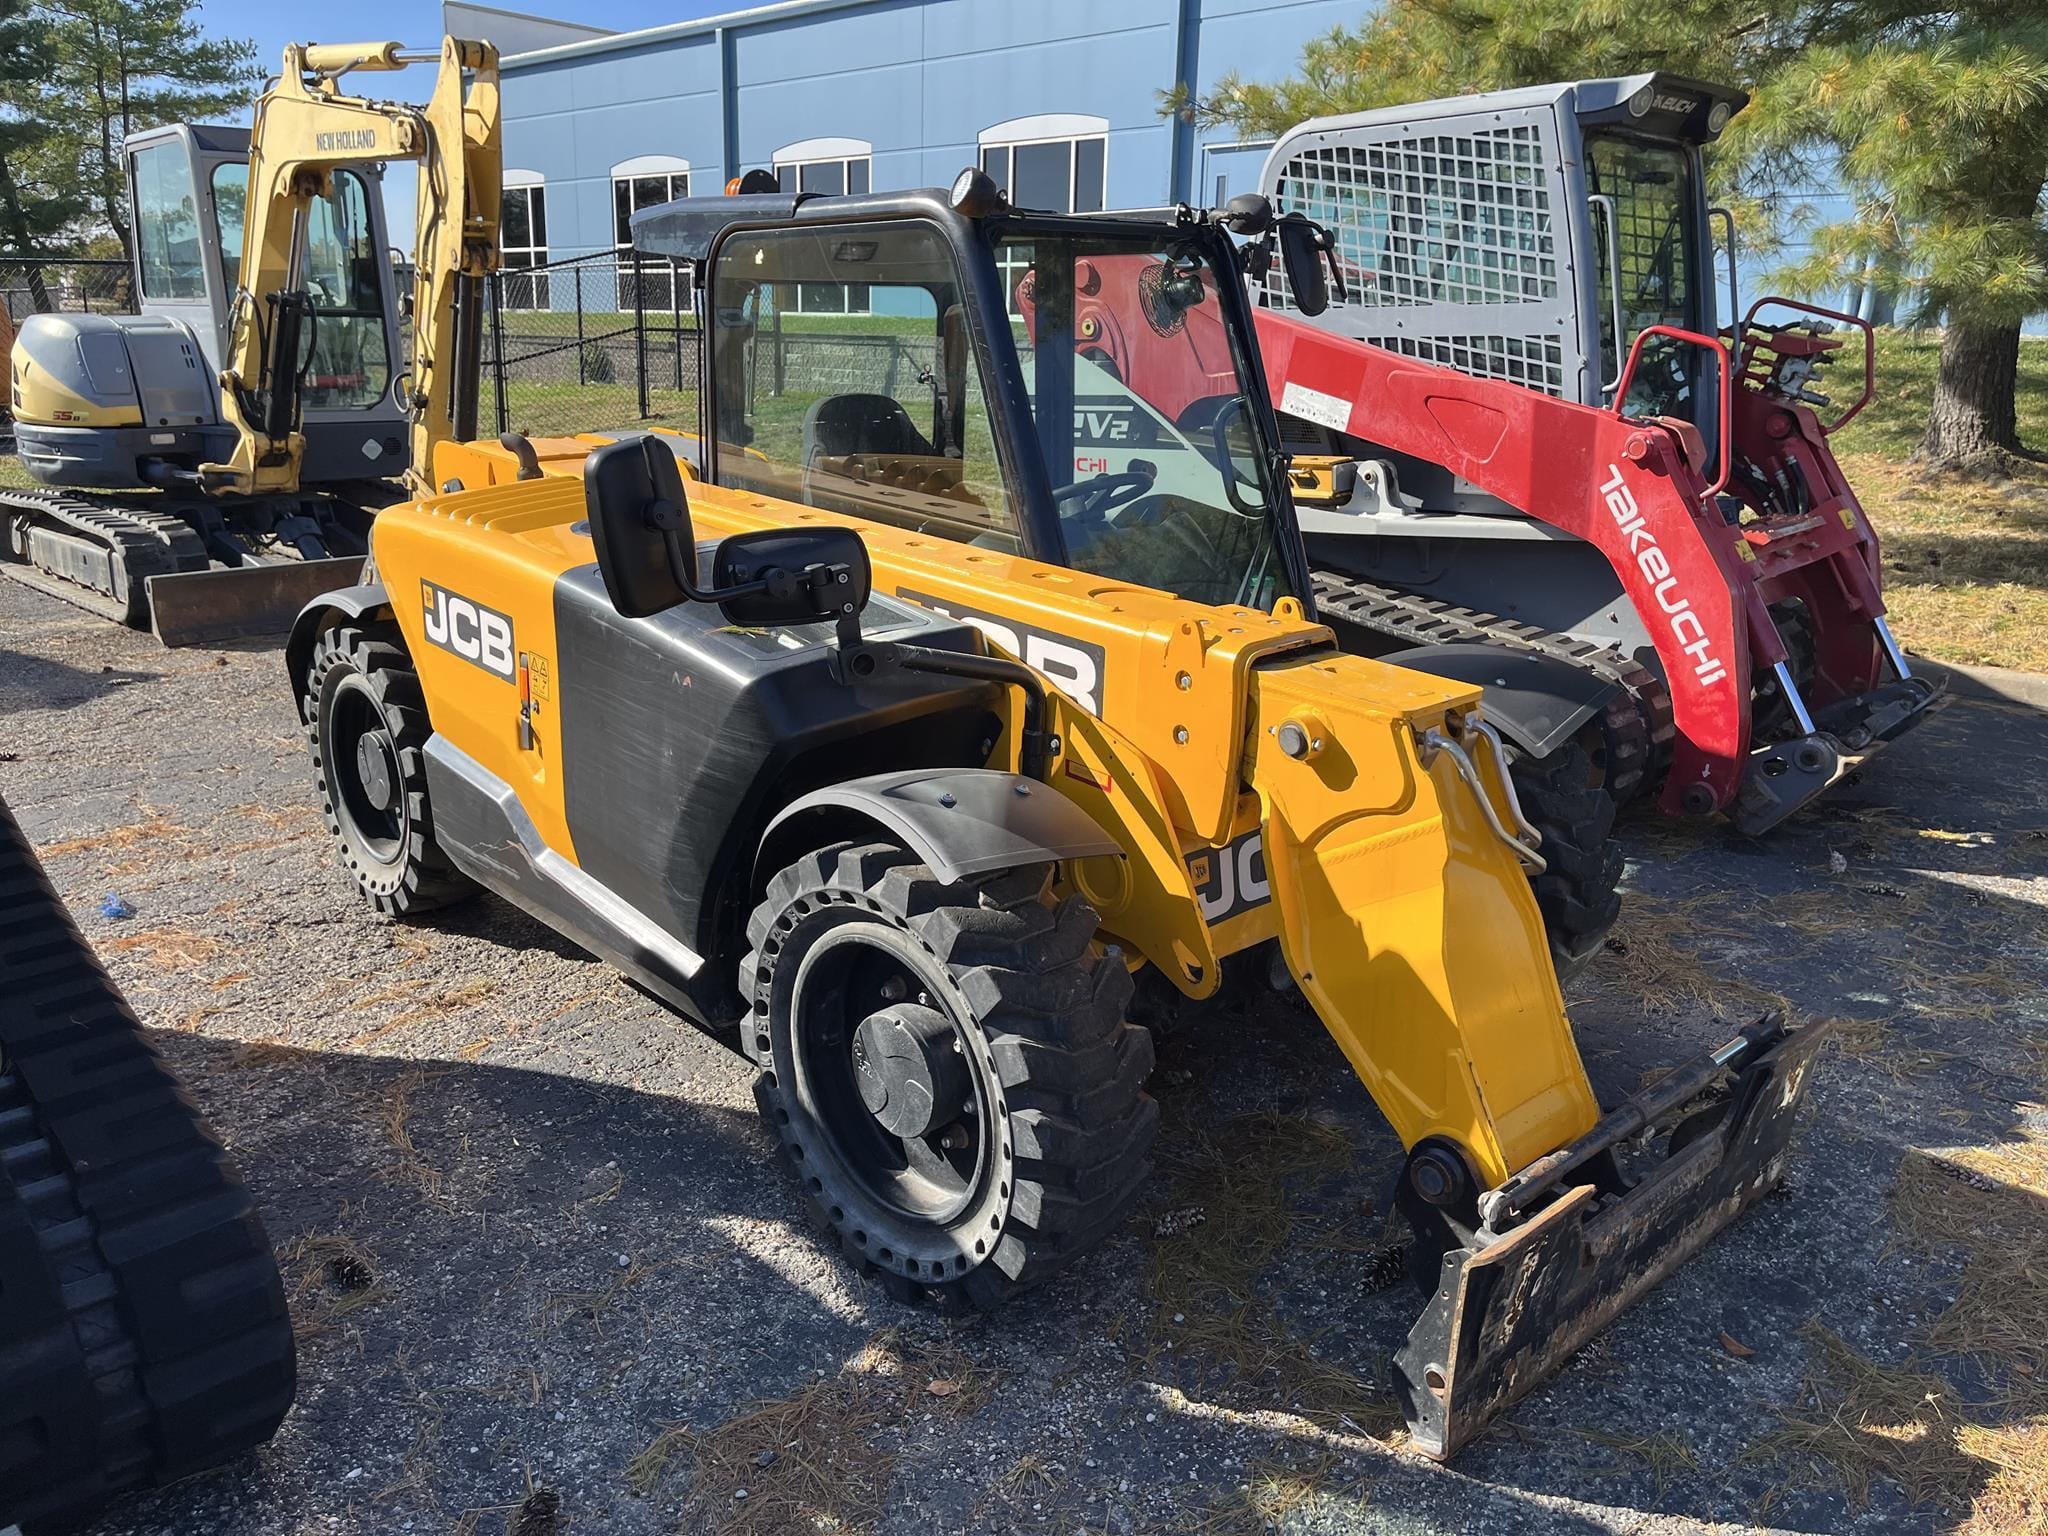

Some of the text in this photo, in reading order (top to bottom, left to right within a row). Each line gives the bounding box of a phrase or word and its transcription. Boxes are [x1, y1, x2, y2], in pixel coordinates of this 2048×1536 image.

[316, 129, 376, 151] NEW HOLLAND
[1600, 463, 1727, 687] TAKEUCHI
[425, 590, 514, 676] JCB
[1197, 835, 1271, 921] JC
